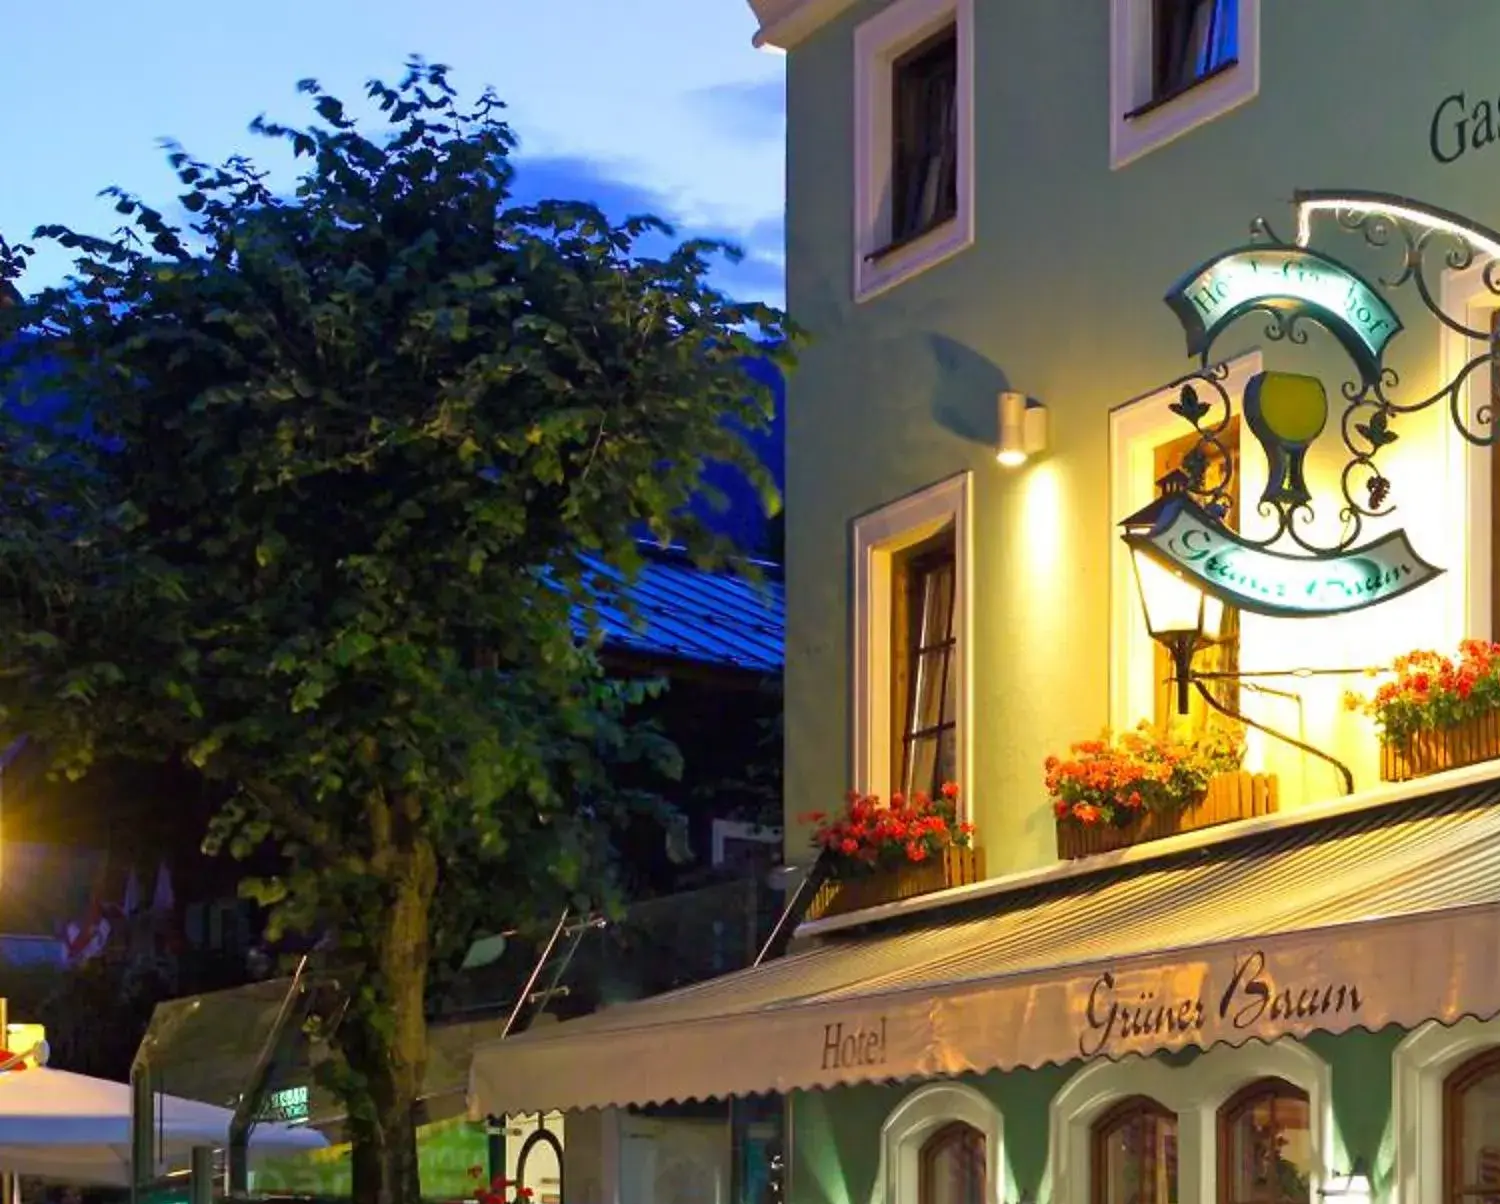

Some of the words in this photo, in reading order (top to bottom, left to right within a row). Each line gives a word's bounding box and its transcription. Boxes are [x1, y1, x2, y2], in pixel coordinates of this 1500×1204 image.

[820, 1017, 887, 1069] Hotel
[1078, 973, 1206, 1056] Grüner
[1220, 950, 1364, 1028] Baum
